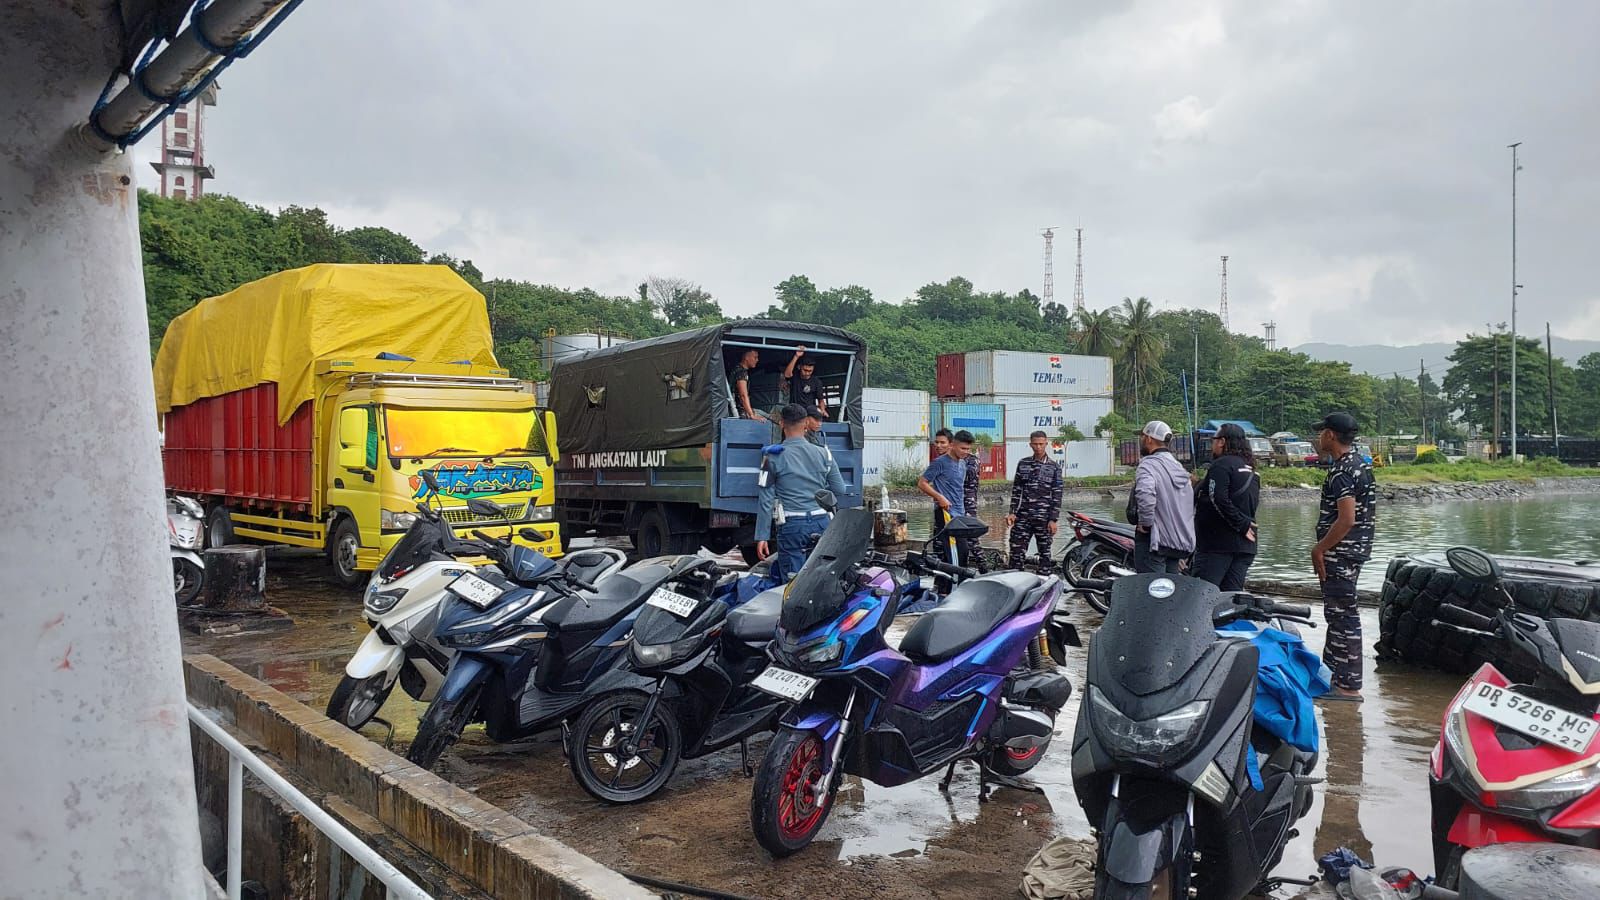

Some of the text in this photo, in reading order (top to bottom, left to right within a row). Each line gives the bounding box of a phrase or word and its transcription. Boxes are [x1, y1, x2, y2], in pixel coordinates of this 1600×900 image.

[572, 450, 667, 469] TNI ANGKATAN LAUT
[775, 671, 799, 684] 2407
[1478, 684, 1503, 702] DR
[1507, 695, 1556, 722] 5266
